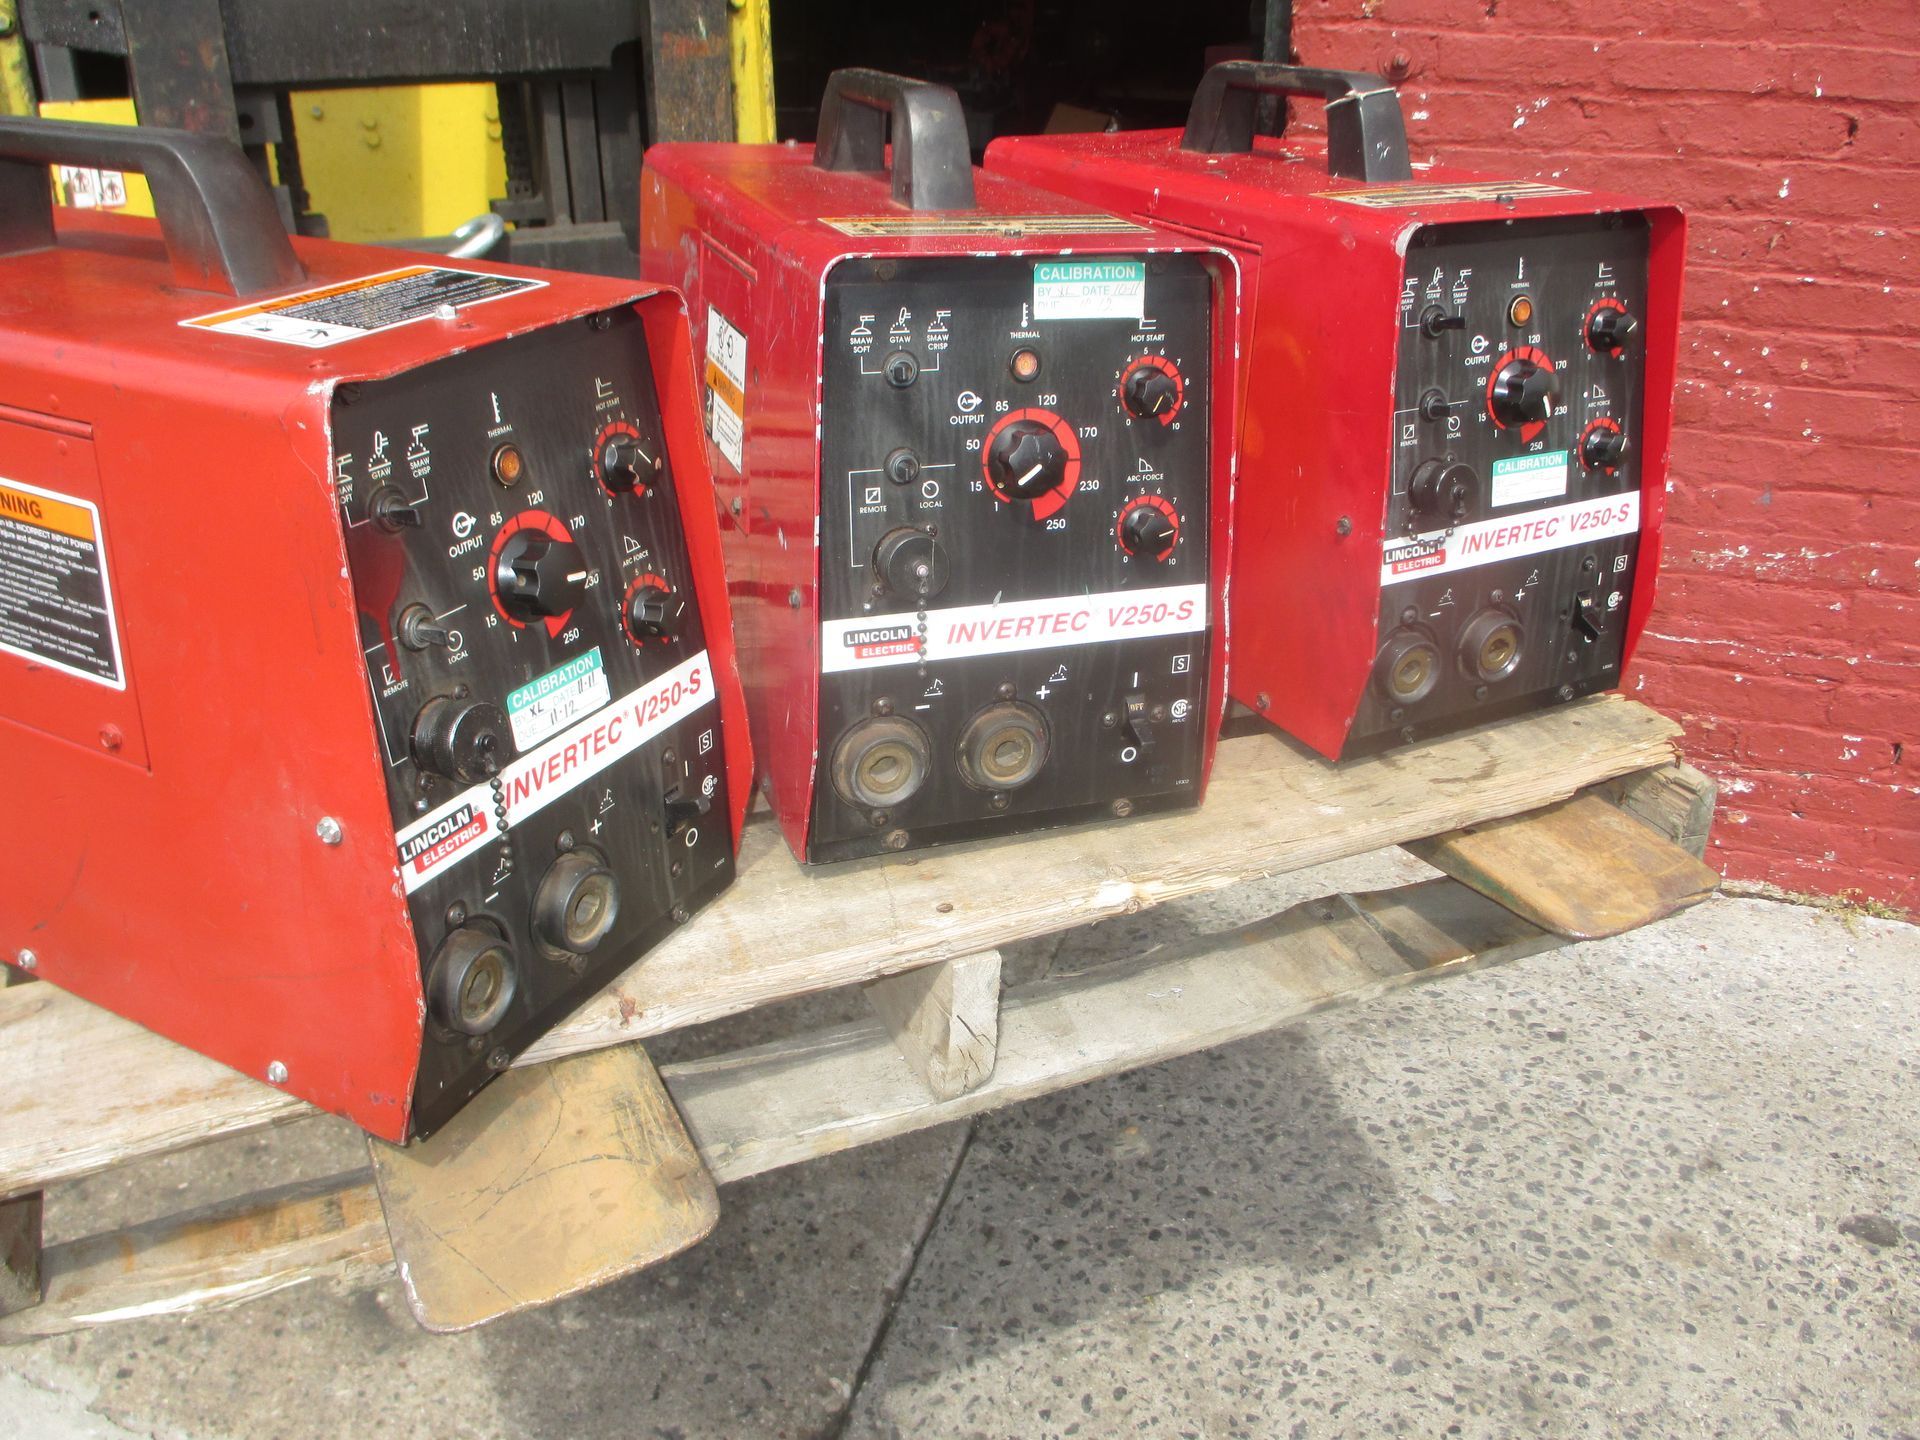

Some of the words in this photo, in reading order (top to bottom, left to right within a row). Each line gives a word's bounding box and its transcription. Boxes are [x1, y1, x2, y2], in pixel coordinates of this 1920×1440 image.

[1039, 265, 1136, 281] CALIBRATION
[1037, 286, 1052, 297] BY
[1082, 285, 1110, 297] DATE
[850, 337, 873, 345] SMAW
[889, 336, 911, 344] GTAW
[926, 334, 949, 342] SMAW
[1010, 331, 1040, 339] THERMAL
[1131, 334, 1144, 342] HOT
[1146, 333, 1165, 341] START
[1528, 334, 1540, 344] 120
[853, 346, 871, 354] SOFT
[928, 342, 948, 351] CRISP
[1498, 341, 1508, 352] 85
[1464, 355, 1490, 366] OUTPUT
[1555, 360, 1567, 370] 170
[1477, 376, 1487, 387] 50
[595, 402, 606, 411] HOT
[606, 397, 620, 408] START
[995, 400, 1009, 412] 85
[1037, 394, 1057, 406] 120
[1554, 405, 1568, 416] 230
[950, 414, 984, 425] OUTPUT
[1478, 412, 1487, 422] 15
[487, 424, 513, 438] THERMAL
[1079, 426, 1098, 438] 170
[966, 439, 980, 451] 50
[1400, 439, 1418, 447] REMOTE
[1530, 441, 1543, 451] 250
[410, 457, 430, 470] SMAW
[1497, 454, 1563, 473] CALIBRATION
[371, 467, 391, 480] GTAW
[412, 465, 431, 478] CRISP
[1142, 473, 1164, 481] FORCE
[338, 484, 353, 495] AW
[970, 481, 983, 492] 15
[1079, 479, 1100, 491] 230
[339, 494, 353, 504] OFT
[527, 490, 544, 507] 120
[919, 500, 943, 509] LOCAL
[860, 505, 887, 514] REMOTE
[490, 511, 503, 527] 85
[569, 514, 585, 531] 170
[1046, 518, 1066, 530] 250
[1461, 517, 1559, 555] INVERTEC
[1570, 503, 1630, 532] V250-S
[449, 534, 483, 558] OUTPUT
[622, 557, 633, 568] ARC
[633, 549, 649, 562] FORCE
[1385, 545, 1435, 563] LINCOLN
[1397, 555, 1441, 572] ELECTRIC
[472, 566, 486, 581] 50
[485, 614, 498, 629] 15
[947, 610, 1090, 644] INVERTEC
[1108, 600, 1195, 628] V250-S
[563, 627, 580, 645] 250
[846, 628, 909, 645] LINCOLN
[862, 643, 915, 657] ELECTRIC
[448, 649, 469, 664] LOCAL
[512, 655, 594, 708] CALIBRATION
[383, 679, 409, 698] REMOTE
[1129, 702, 1144, 712] OFF
[505, 716, 623, 810] INVERTEC
[634, 668, 701, 728] V250-S
[401, 808, 471, 862] LINCOLN
[422, 822, 481, 868] ELECTRIC
